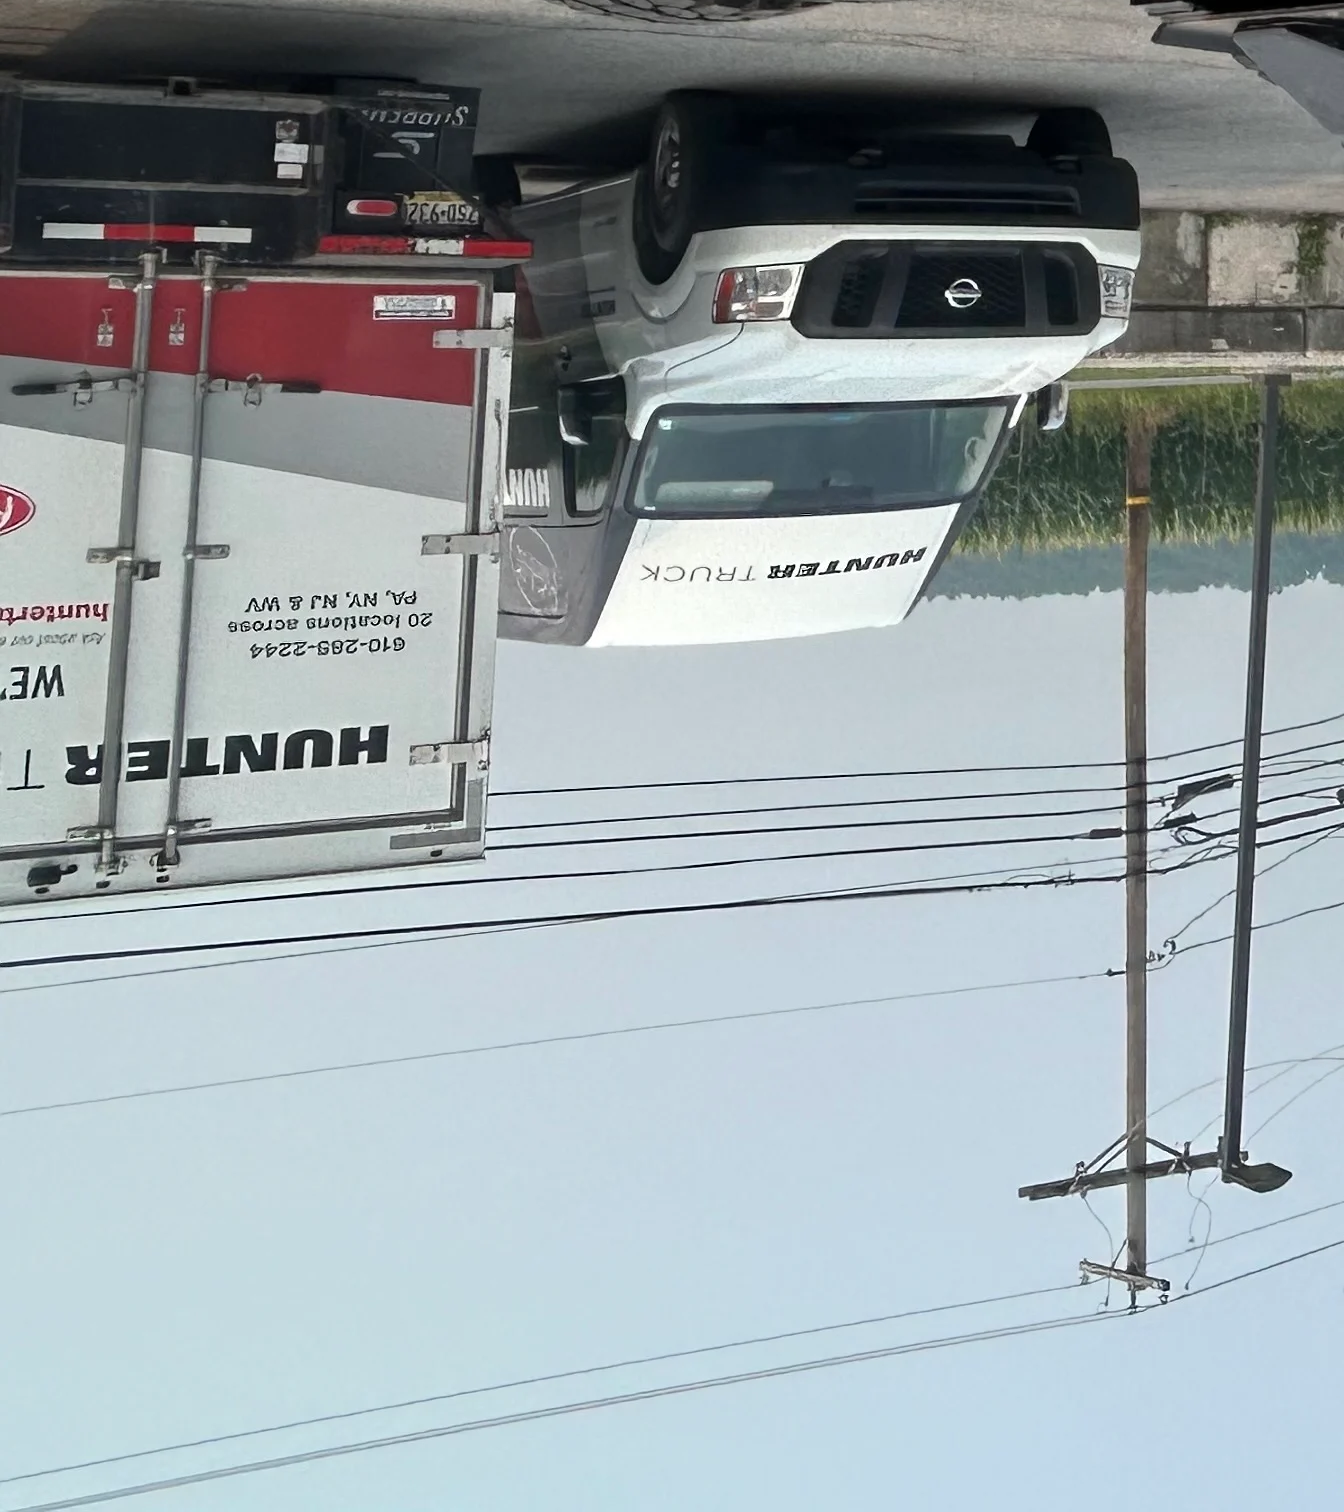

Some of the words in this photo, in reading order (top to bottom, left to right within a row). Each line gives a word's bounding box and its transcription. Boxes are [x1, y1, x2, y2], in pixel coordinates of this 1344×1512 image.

[766, 546, 928, 581] HUNTER
[639, 563, 757, 584] TRUCK
[244, 596, 280, 613] WV
[288, 596, 303, 611] &
[310, 594, 338, 610] NJ
[345, 592, 378, 608] NY,
[385, 590, 418, 606] PA,
[227, 618, 299, 633] across
[306, 614, 401, 630] locations
[408, 612, 433, 628] 20
[249, 636, 406, 659] 610-285-2244
[64, 725, 389, 786] HUNTER
